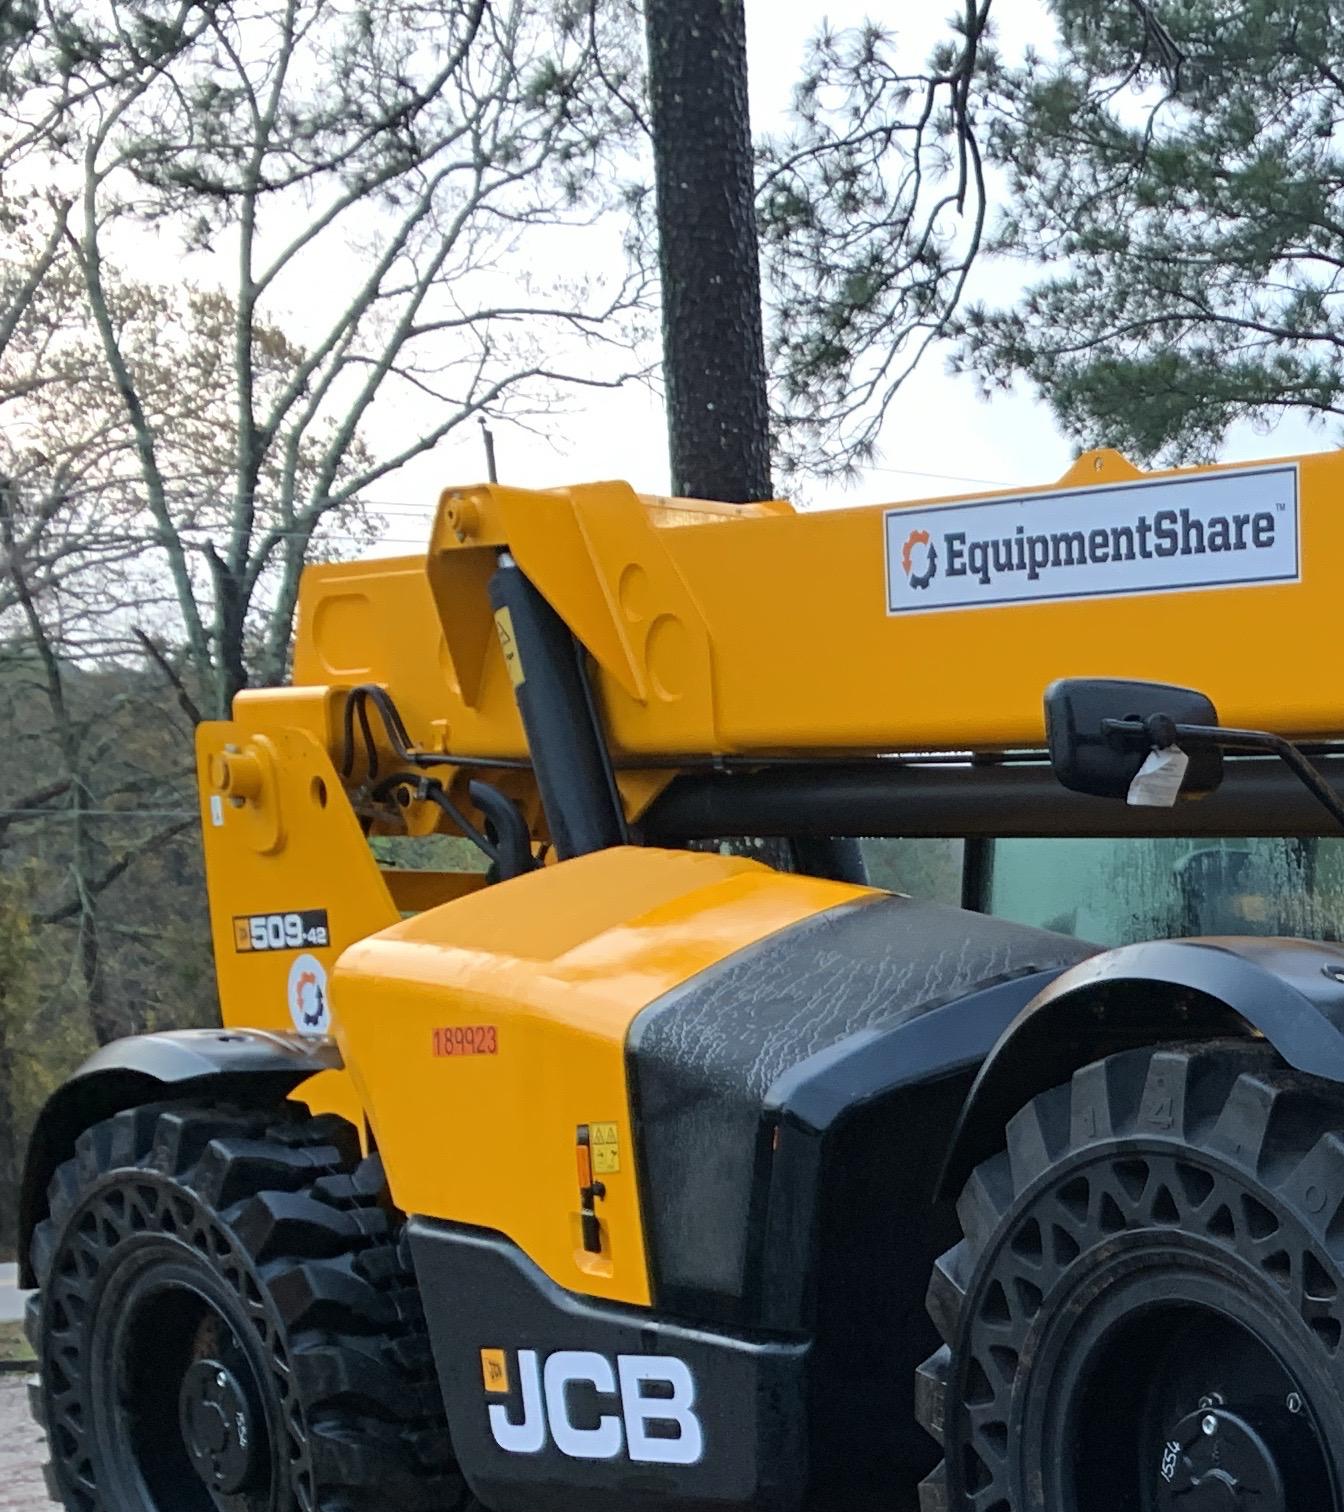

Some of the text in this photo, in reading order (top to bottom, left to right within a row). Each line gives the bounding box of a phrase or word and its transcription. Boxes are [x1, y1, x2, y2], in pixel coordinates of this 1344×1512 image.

[944, 508, 1276, 585] EquipmentShare
[433, 1025, 497, 1056] 189923
[488, 1349, 702, 1464] JCB
[1160, 1440, 1181, 1483] 1554
